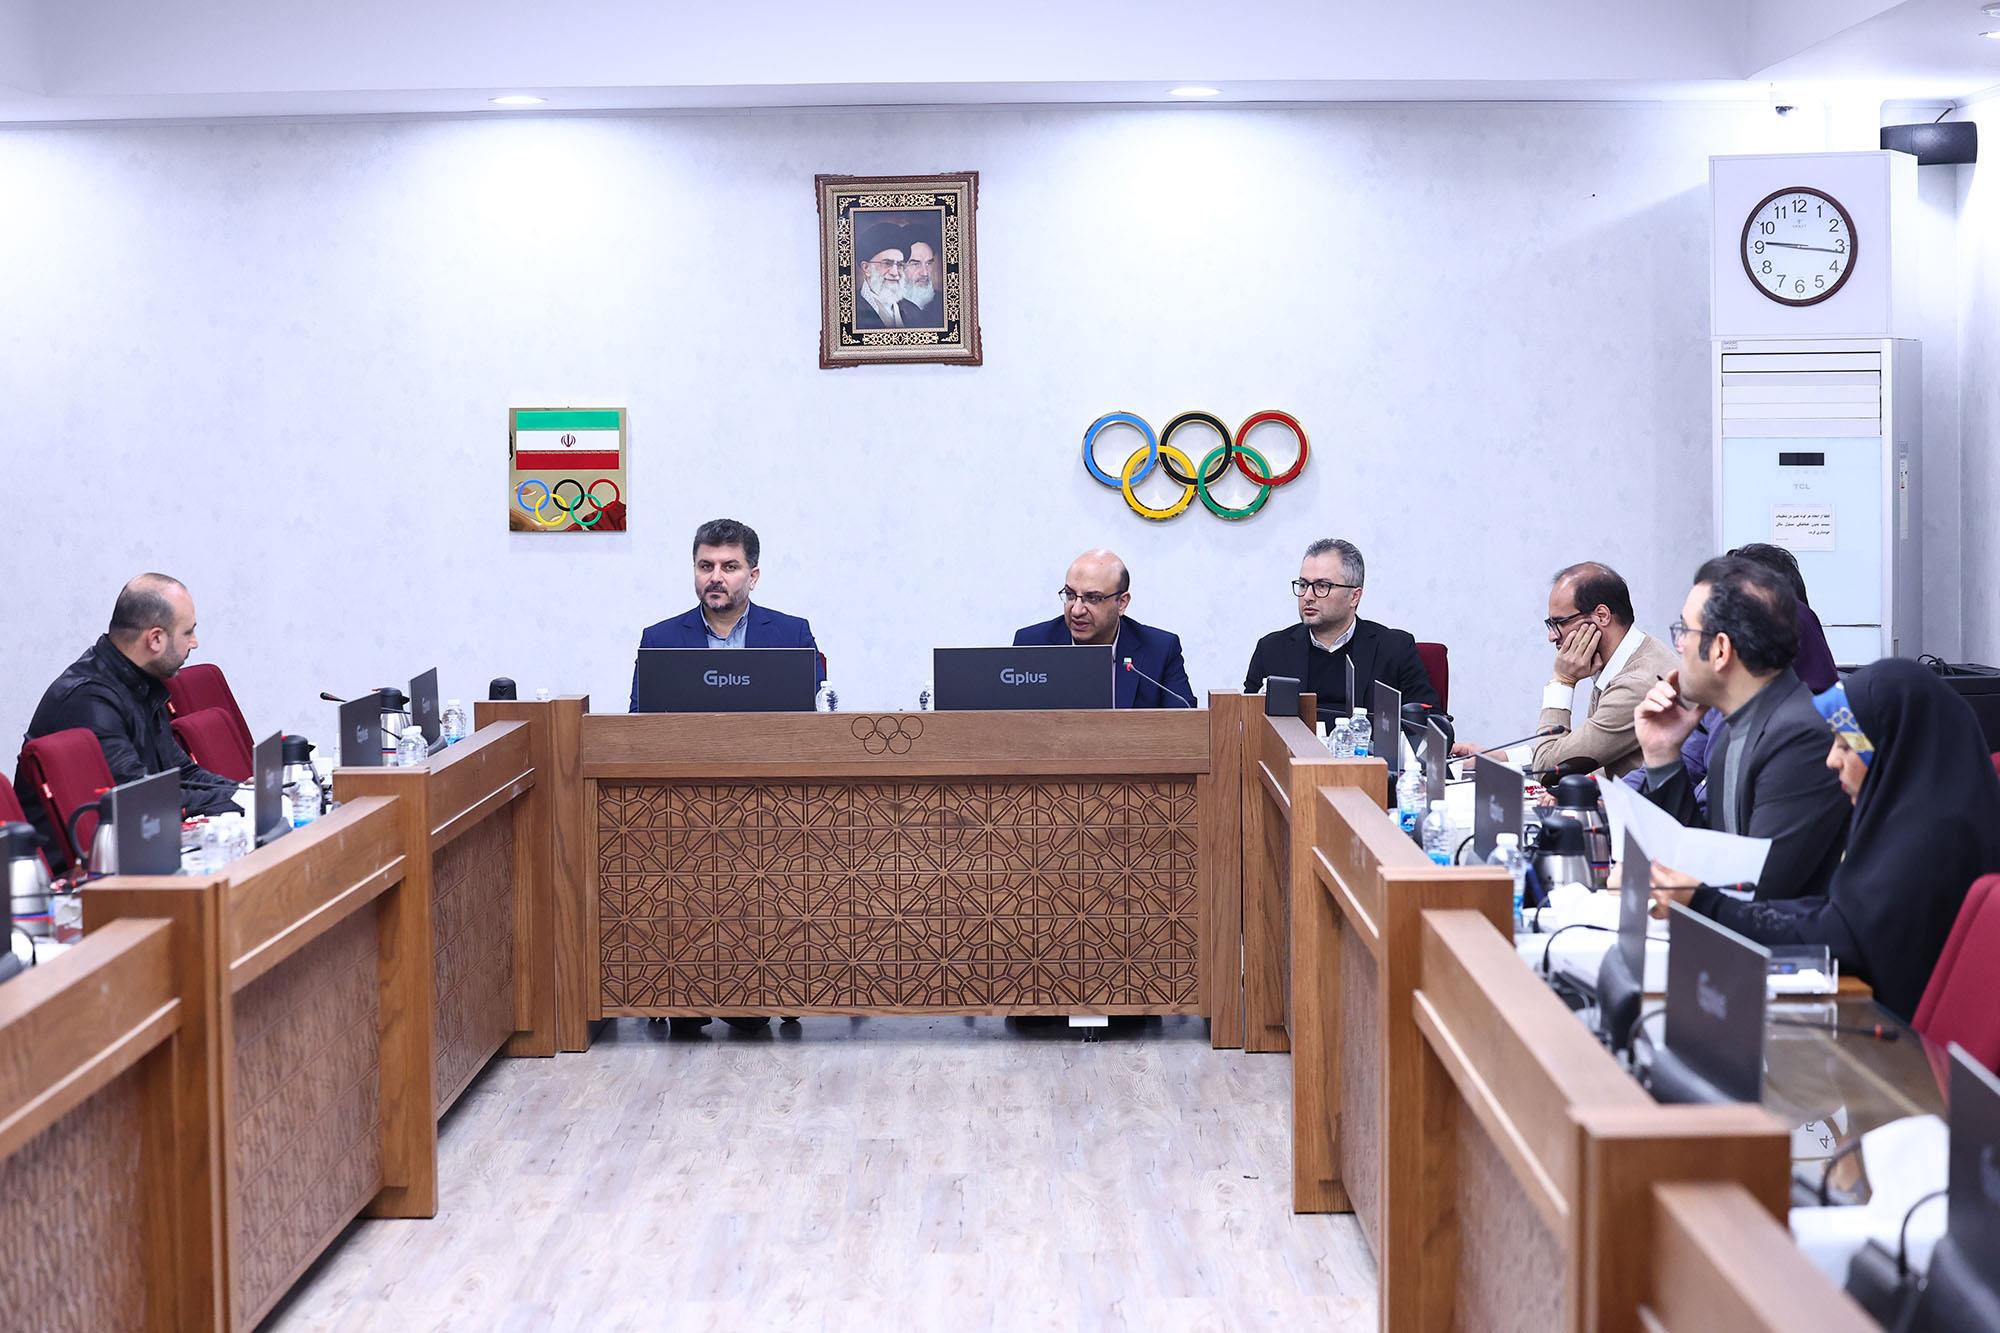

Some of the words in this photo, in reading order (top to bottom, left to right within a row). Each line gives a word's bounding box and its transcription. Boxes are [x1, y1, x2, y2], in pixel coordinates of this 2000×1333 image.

[1774, 206, 1787, 219] 11
[1792, 199, 1807, 213] 12
[1816, 205, 1822, 218] 1
[1760, 221, 1775, 235] 10
[1829, 218, 1839, 232] 2
[1754, 240, 1765, 254] 9
[1835, 239, 1845, 253] 3
[1762, 260, 1772, 274] 8
[1829, 260, 1839, 273] 4
[1777, 275, 1787, 288] 7
[1795, 280, 1805, 293] 6
[1814, 275, 1824, 288] 5
[703, 670, 751, 688] Gplus
[1000, 668, 1048, 686] Gplus
